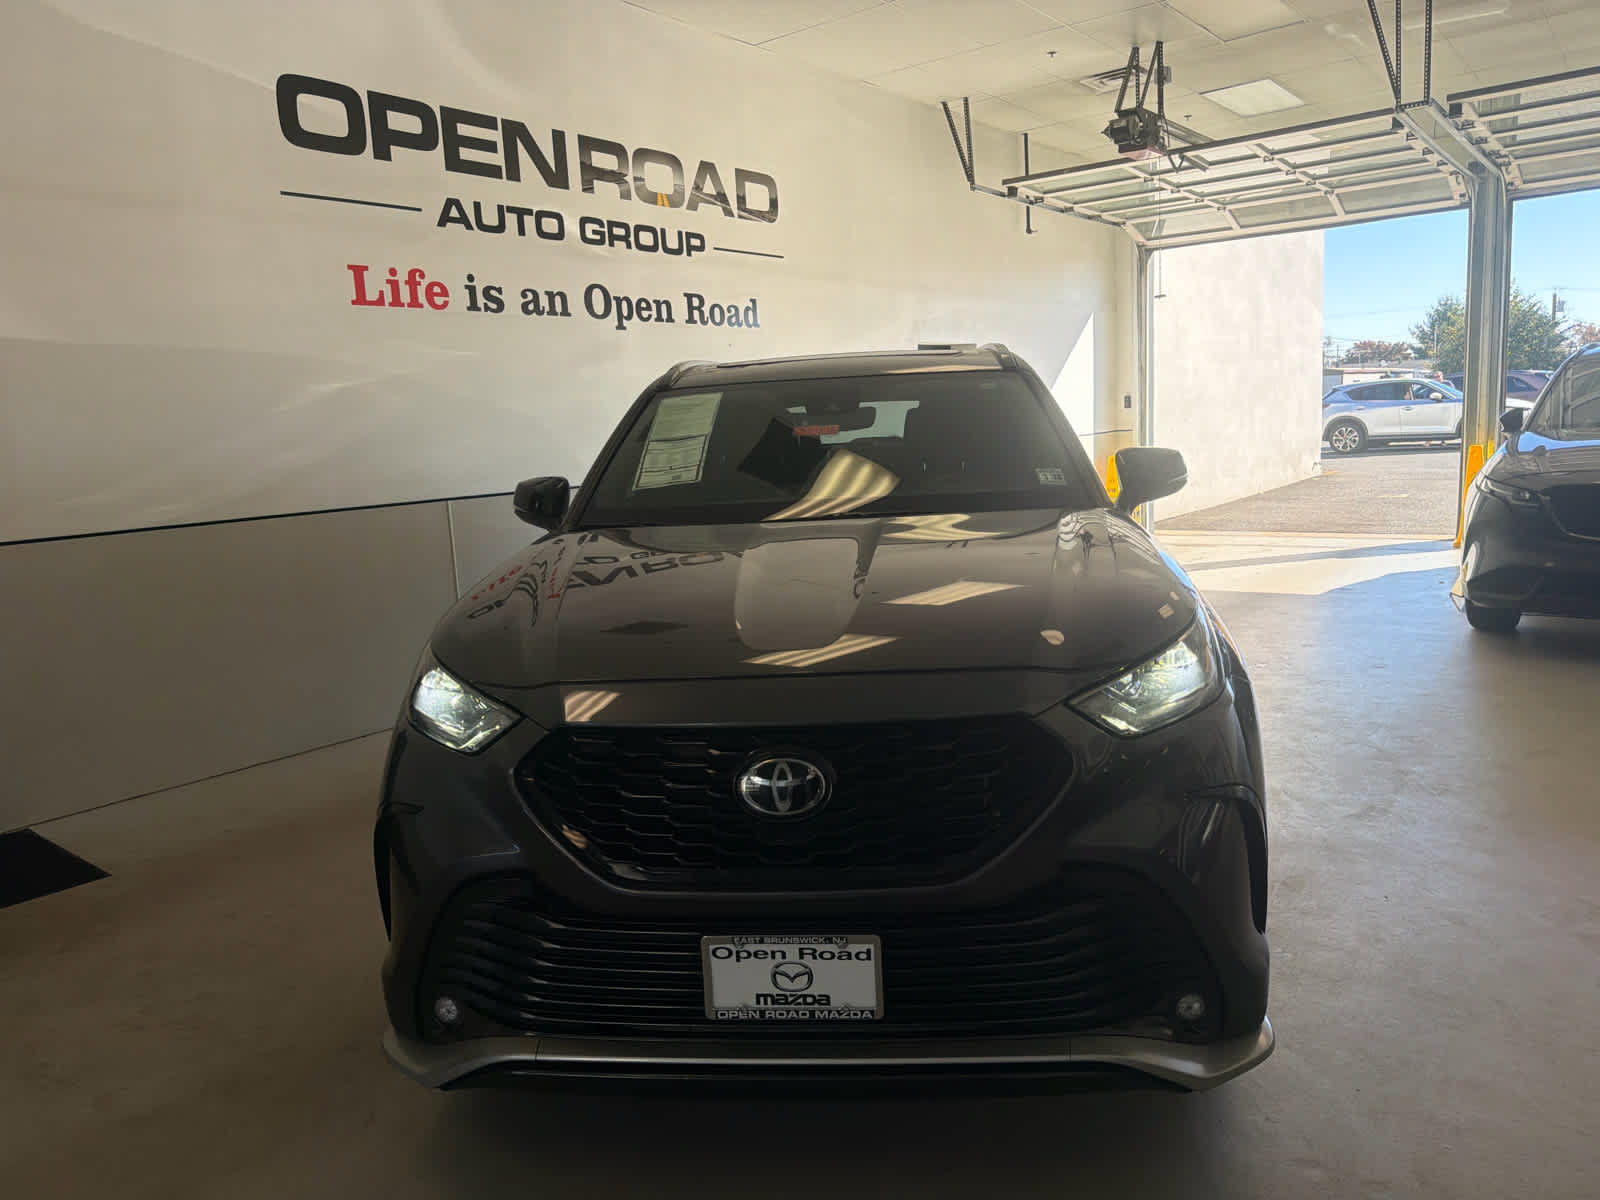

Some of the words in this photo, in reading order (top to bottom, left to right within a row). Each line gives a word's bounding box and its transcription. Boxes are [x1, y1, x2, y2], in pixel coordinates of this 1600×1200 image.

[437, 197, 565, 241] AUTO
[578, 216, 706, 257] GROUP
[347, 264, 450, 311] Life
[464, 274, 505, 314] is
[520, 289, 572, 317] an
[583, 283, 675, 331] Open
[683, 292, 761, 329] Road
[733, 936, 761, 944] EAST
[711, 946, 787, 963] Open
[798, 947, 872, 961] Road
[717, 1010, 760, 1019] OPEN
[765, 1010, 810, 1019] ROAD
[815, 1010, 873, 1019] MAZDA
